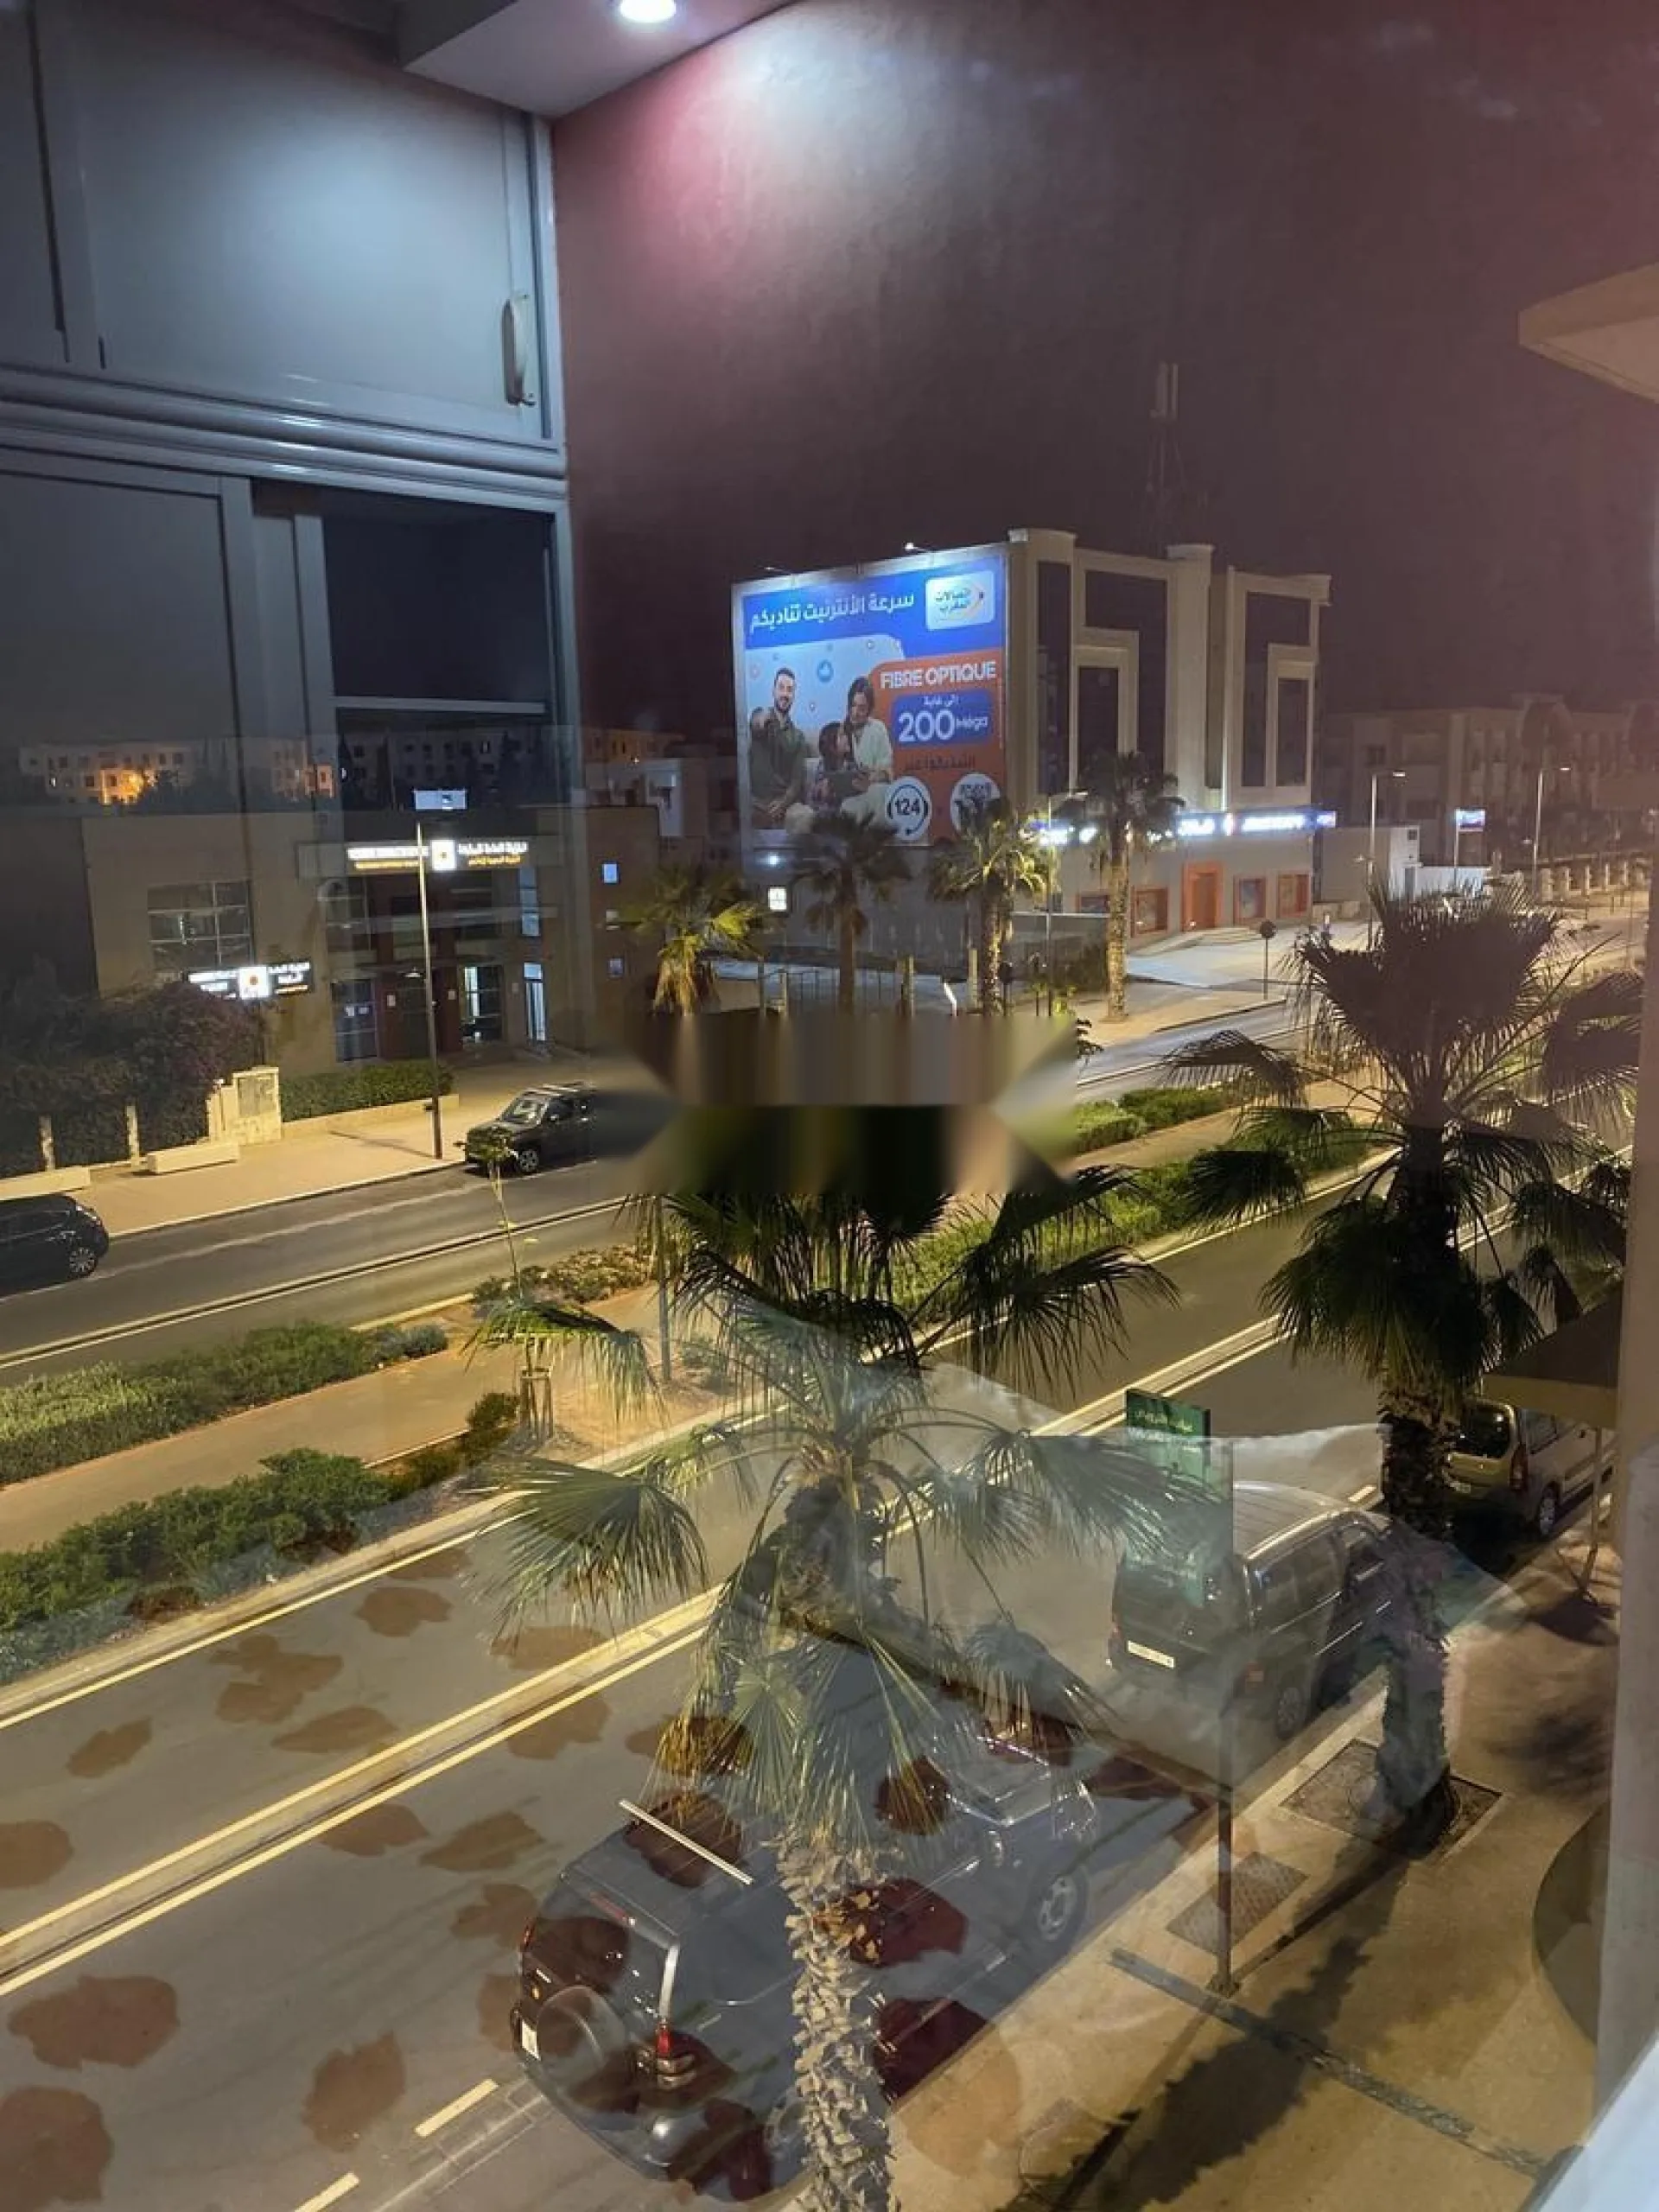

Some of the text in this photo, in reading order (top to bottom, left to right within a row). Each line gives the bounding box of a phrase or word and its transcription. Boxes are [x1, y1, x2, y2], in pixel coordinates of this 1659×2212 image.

[868, 592, 914, 613] سرعة
[880, 661, 996, 690] FIBRE OPTIQUE
[898, 709, 955, 742] 200
[894, 798, 920, 816] 124
